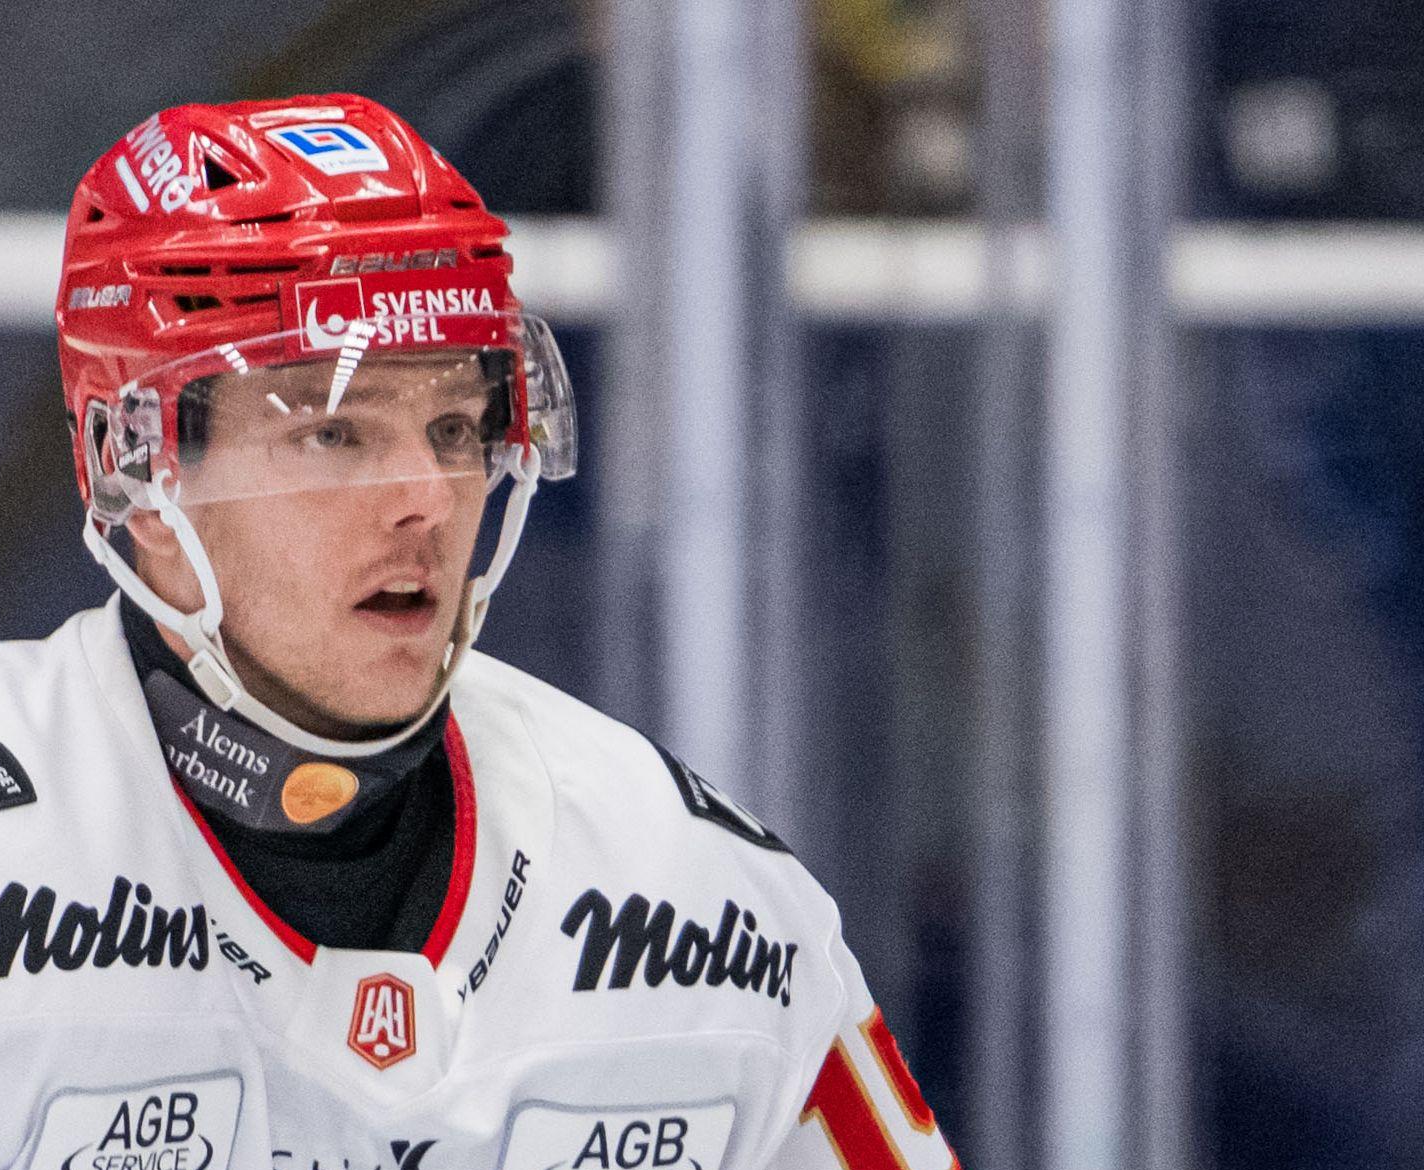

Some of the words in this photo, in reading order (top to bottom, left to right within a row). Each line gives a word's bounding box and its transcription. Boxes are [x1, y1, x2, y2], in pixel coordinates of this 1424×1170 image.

[372, 288, 494, 318] SVENSKA
[377, 316, 446, 346] SPEL
[180, 707, 270, 775] Ålems
[560, 888, 798, 1007] Molins
[97, 1091, 199, 1151] AGB
[573, 1117, 689, 1170] AGB
